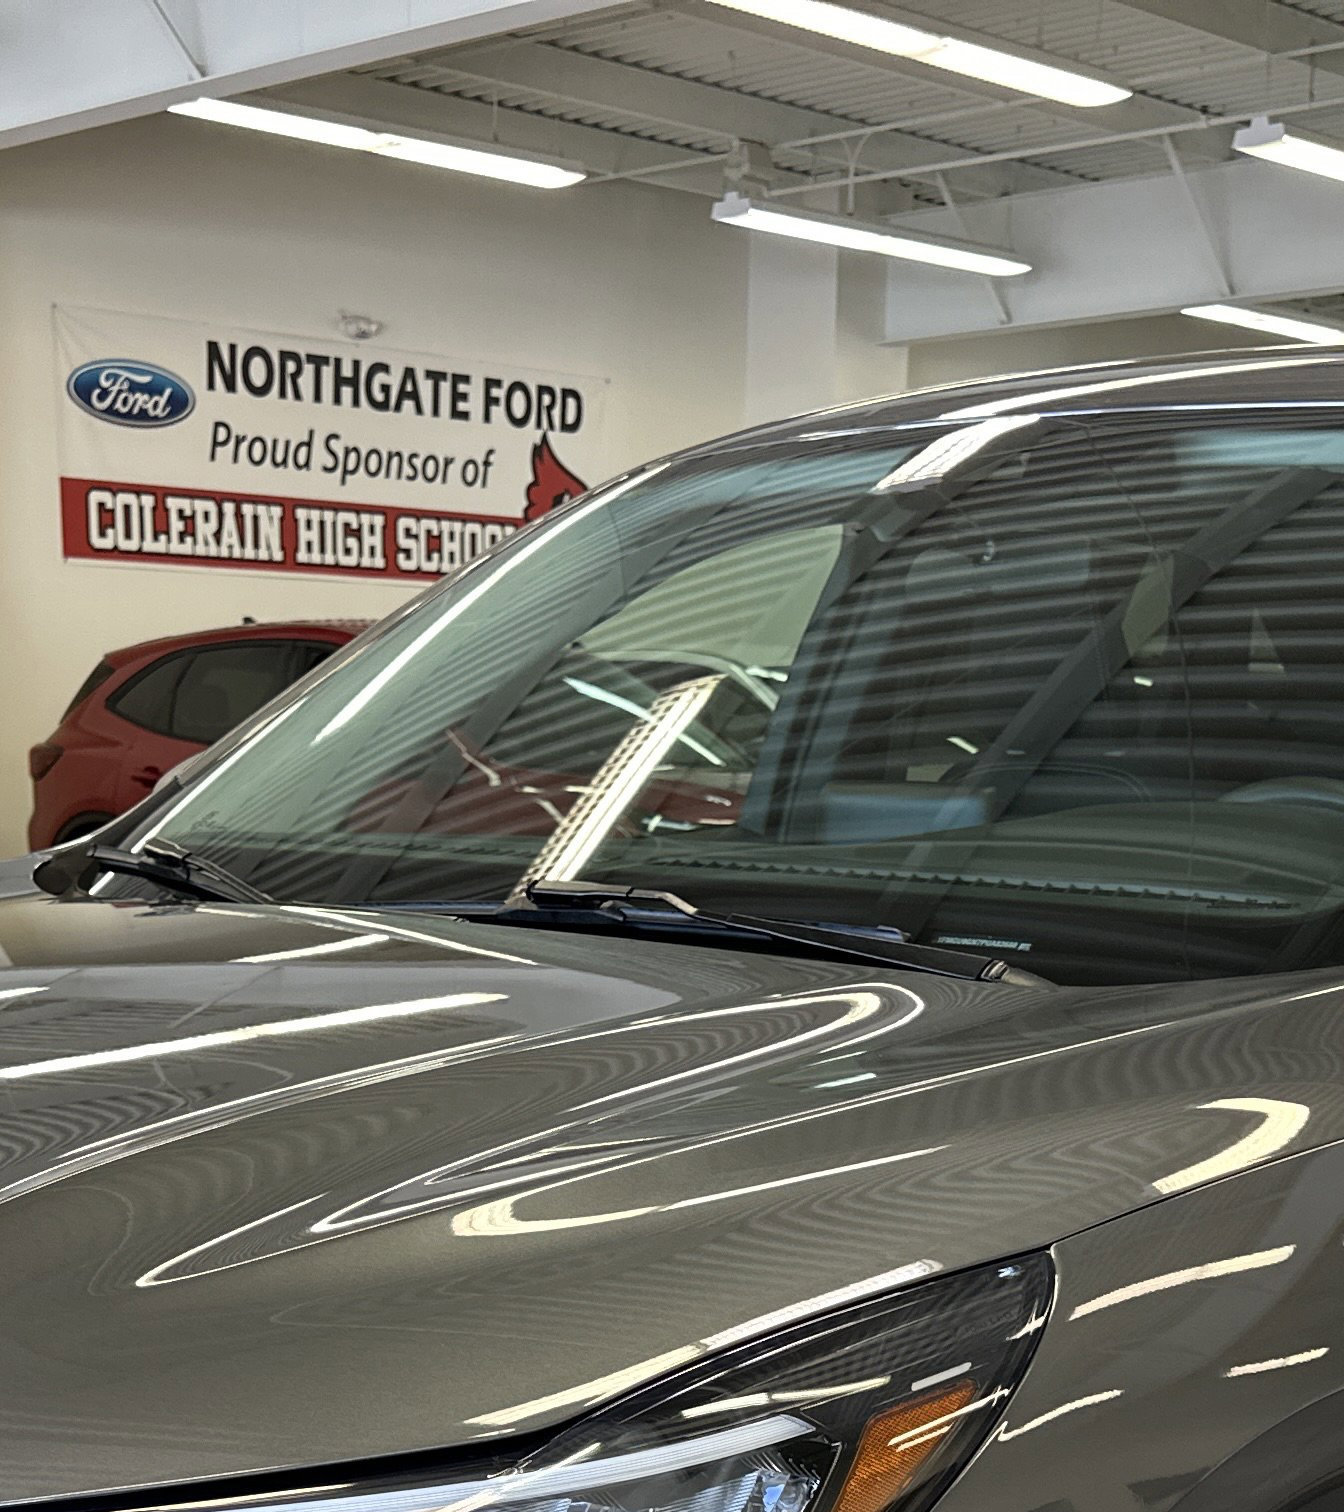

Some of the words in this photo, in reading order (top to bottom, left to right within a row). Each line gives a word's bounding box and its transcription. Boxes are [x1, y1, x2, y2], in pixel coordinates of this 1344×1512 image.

[90, 368, 173, 418] Ford
[206, 340, 471, 422] NORTHGATE
[482, 376, 584, 434] FORD
[209, 421, 314, 471] Proud
[321, 433, 455, 486] Sponsor
[460, 449, 496, 488] of
[86, 487, 286, 564] COLERAIN
[293, 506, 387, 570] HIGH
[394, 514, 517, 575] SCHOO
